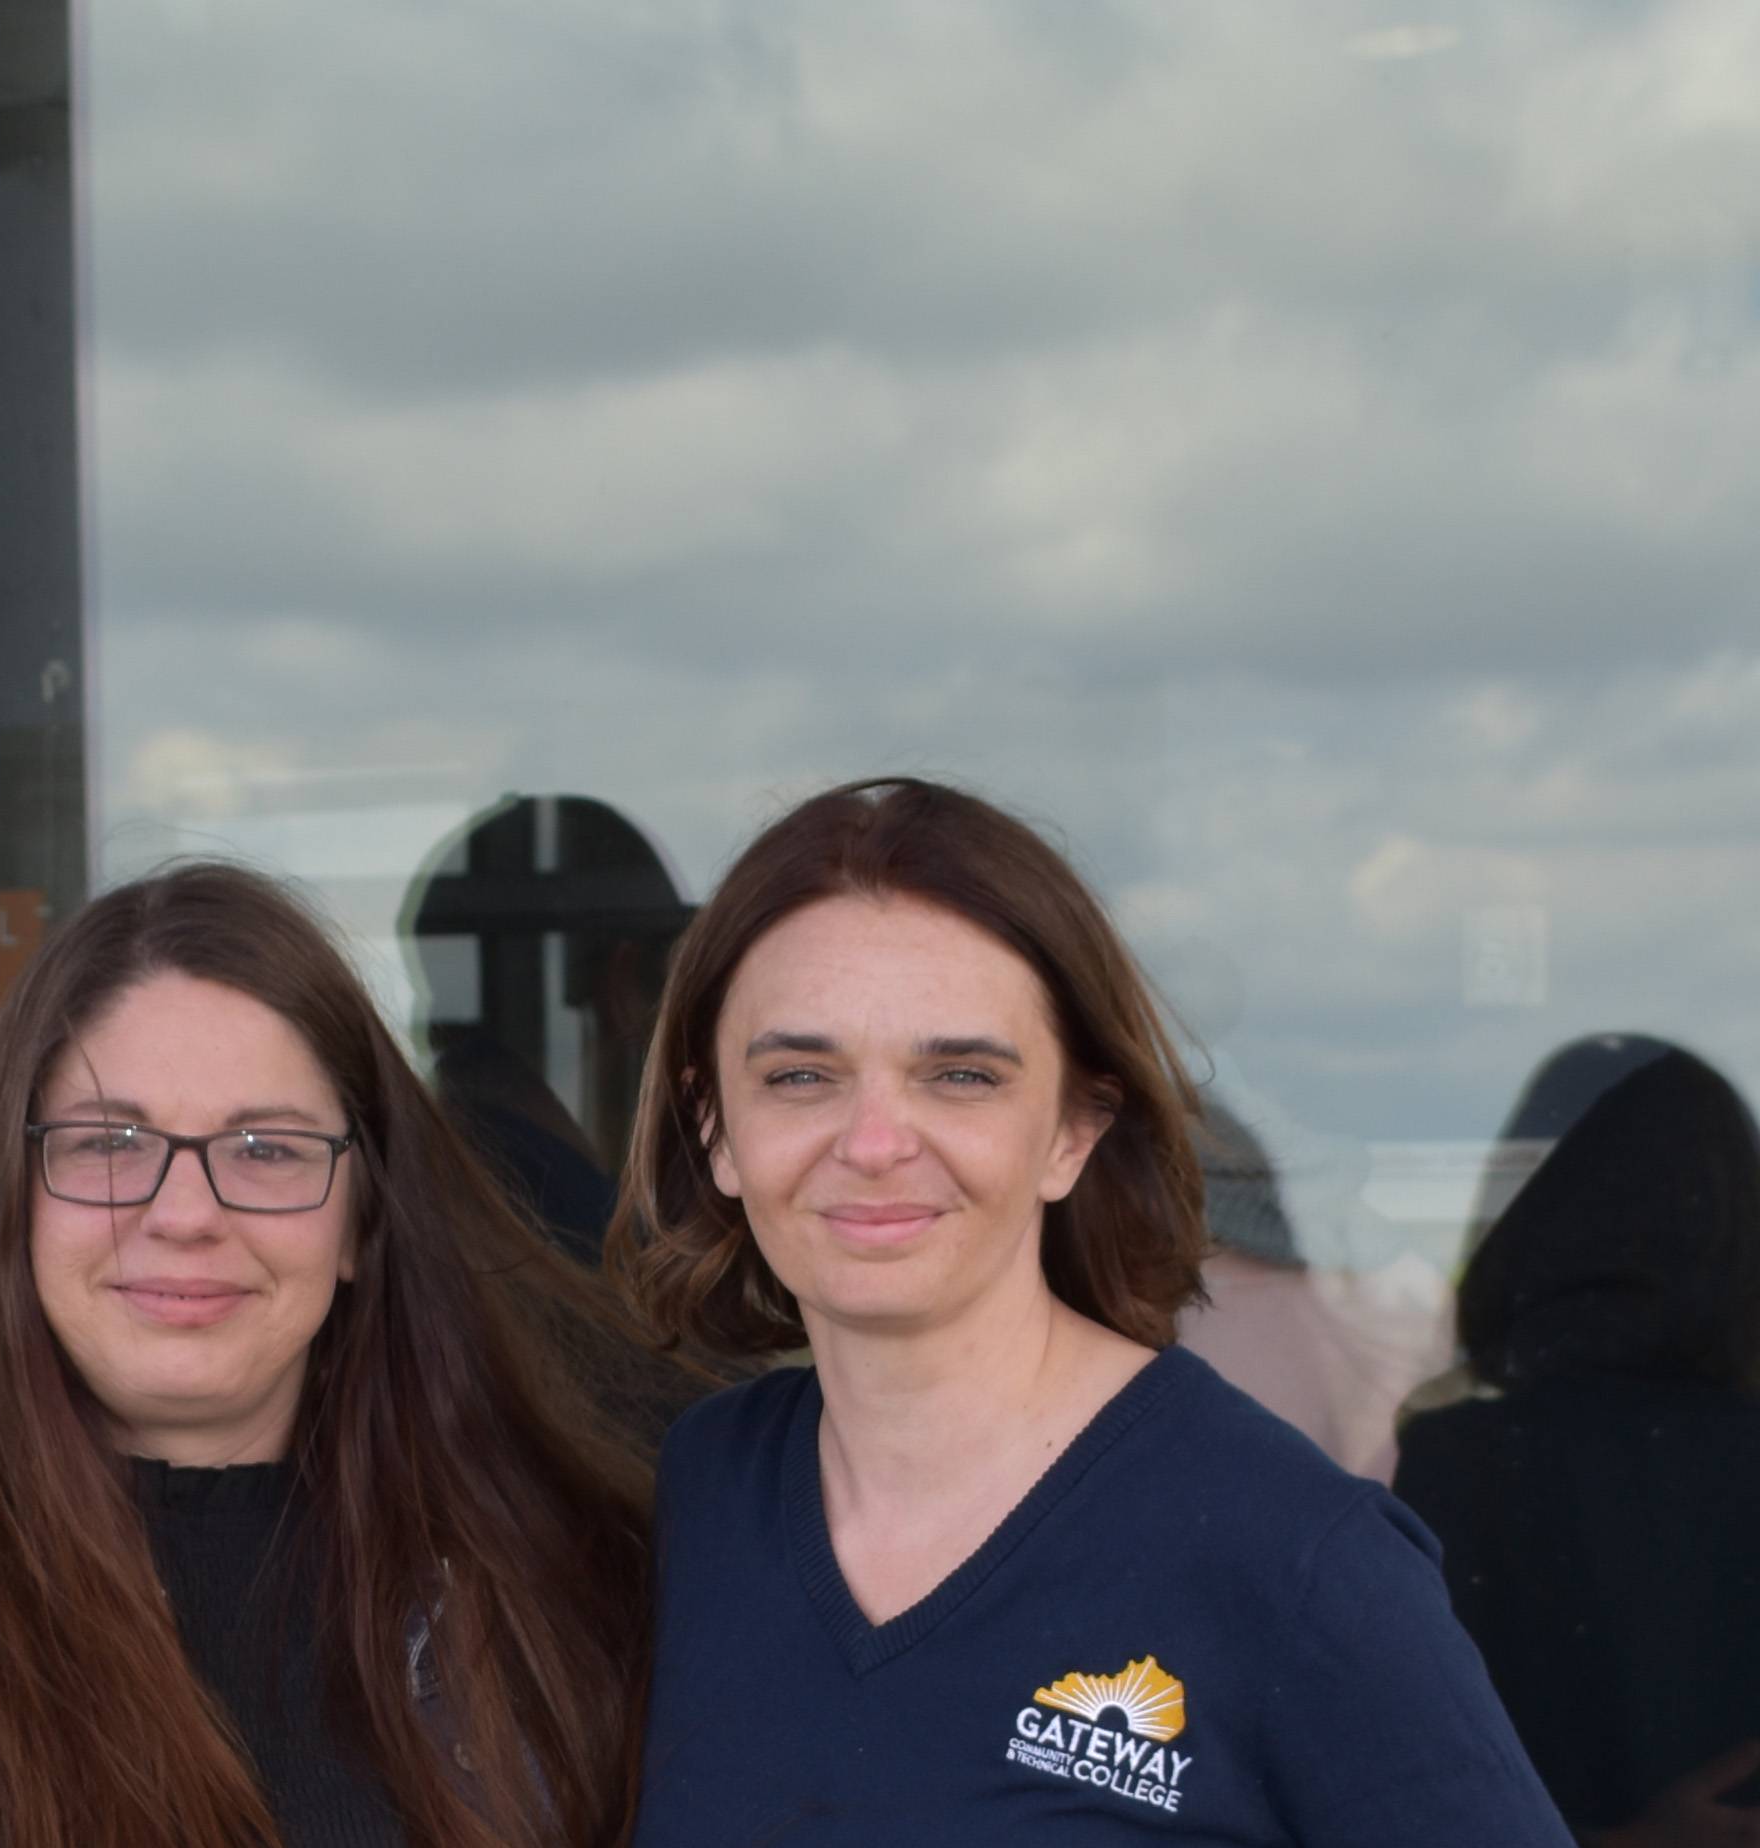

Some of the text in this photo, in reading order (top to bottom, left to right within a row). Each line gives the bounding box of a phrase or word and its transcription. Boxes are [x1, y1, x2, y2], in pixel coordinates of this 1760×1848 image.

[1009, 1737, 1075, 1766] COMMUNITY
[1015, 1706, 1192, 1787] GATEWAY
[1016, 1749, 1071, 1778] TECHNICAL
[1073, 1759, 1183, 1813] COLLEGE
